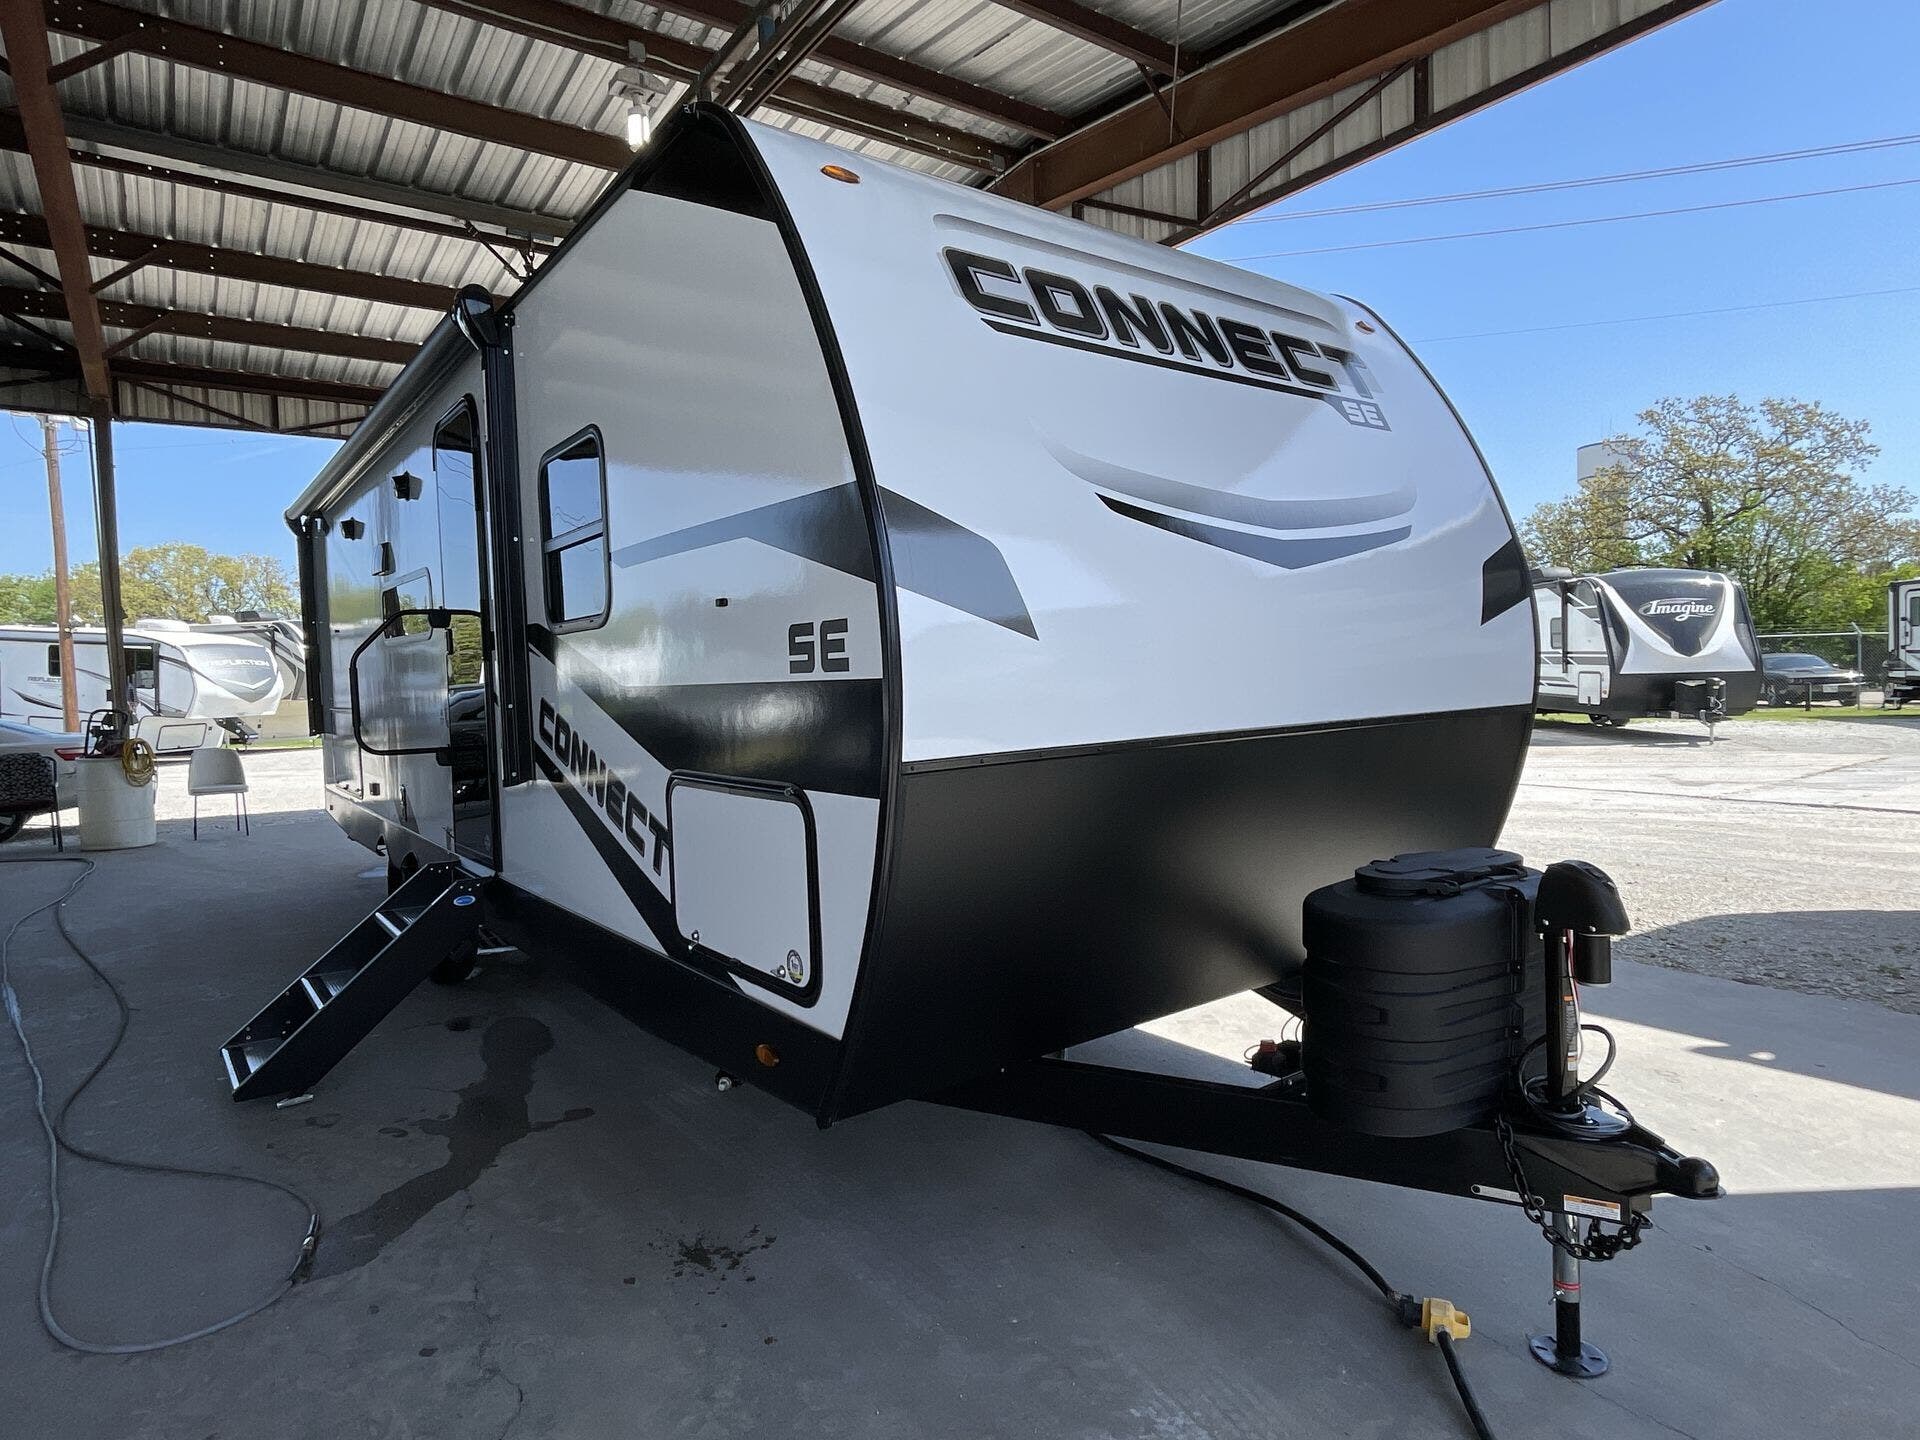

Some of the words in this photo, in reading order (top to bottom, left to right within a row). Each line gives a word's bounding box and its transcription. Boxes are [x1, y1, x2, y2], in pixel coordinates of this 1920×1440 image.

[942, 245, 1375, 400] CONNECT
[1341, 401, 1385, 427] SE
[1646, 600, 1715, 622] Imagine
[788, 618, 850, 674] SE
[539, 696, 672, 877] CONNECT
